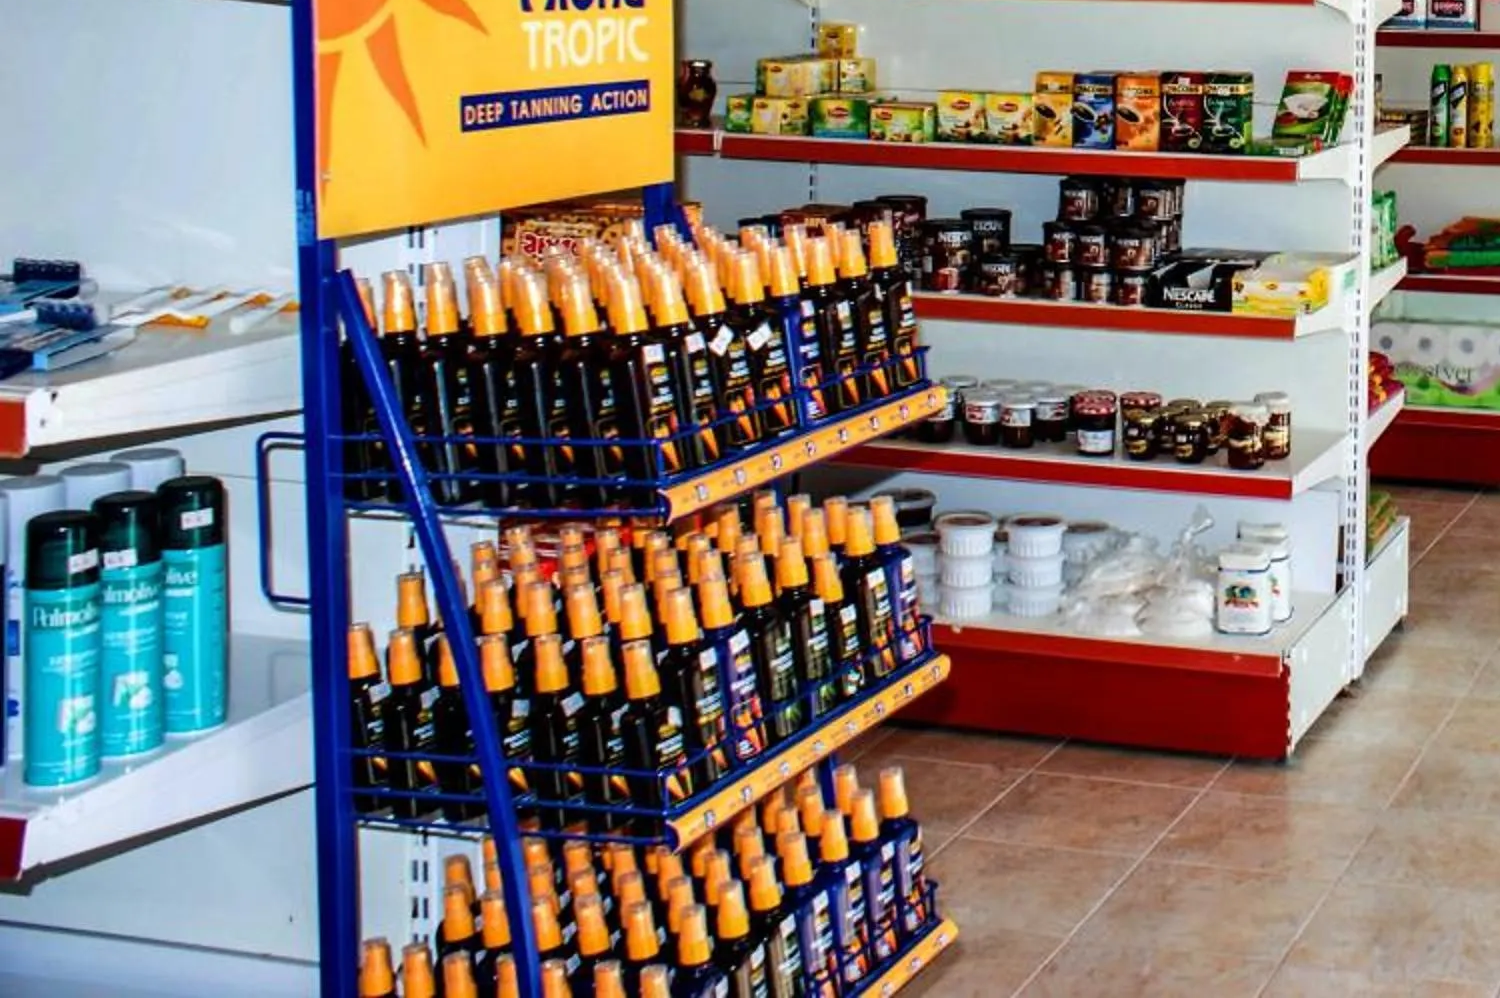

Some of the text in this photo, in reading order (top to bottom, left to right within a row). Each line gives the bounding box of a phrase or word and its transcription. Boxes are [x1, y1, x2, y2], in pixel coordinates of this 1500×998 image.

[520, 15, 649, 71] TROPIC
[463, 88, 648, 126] DEEP TANNING ACTION
